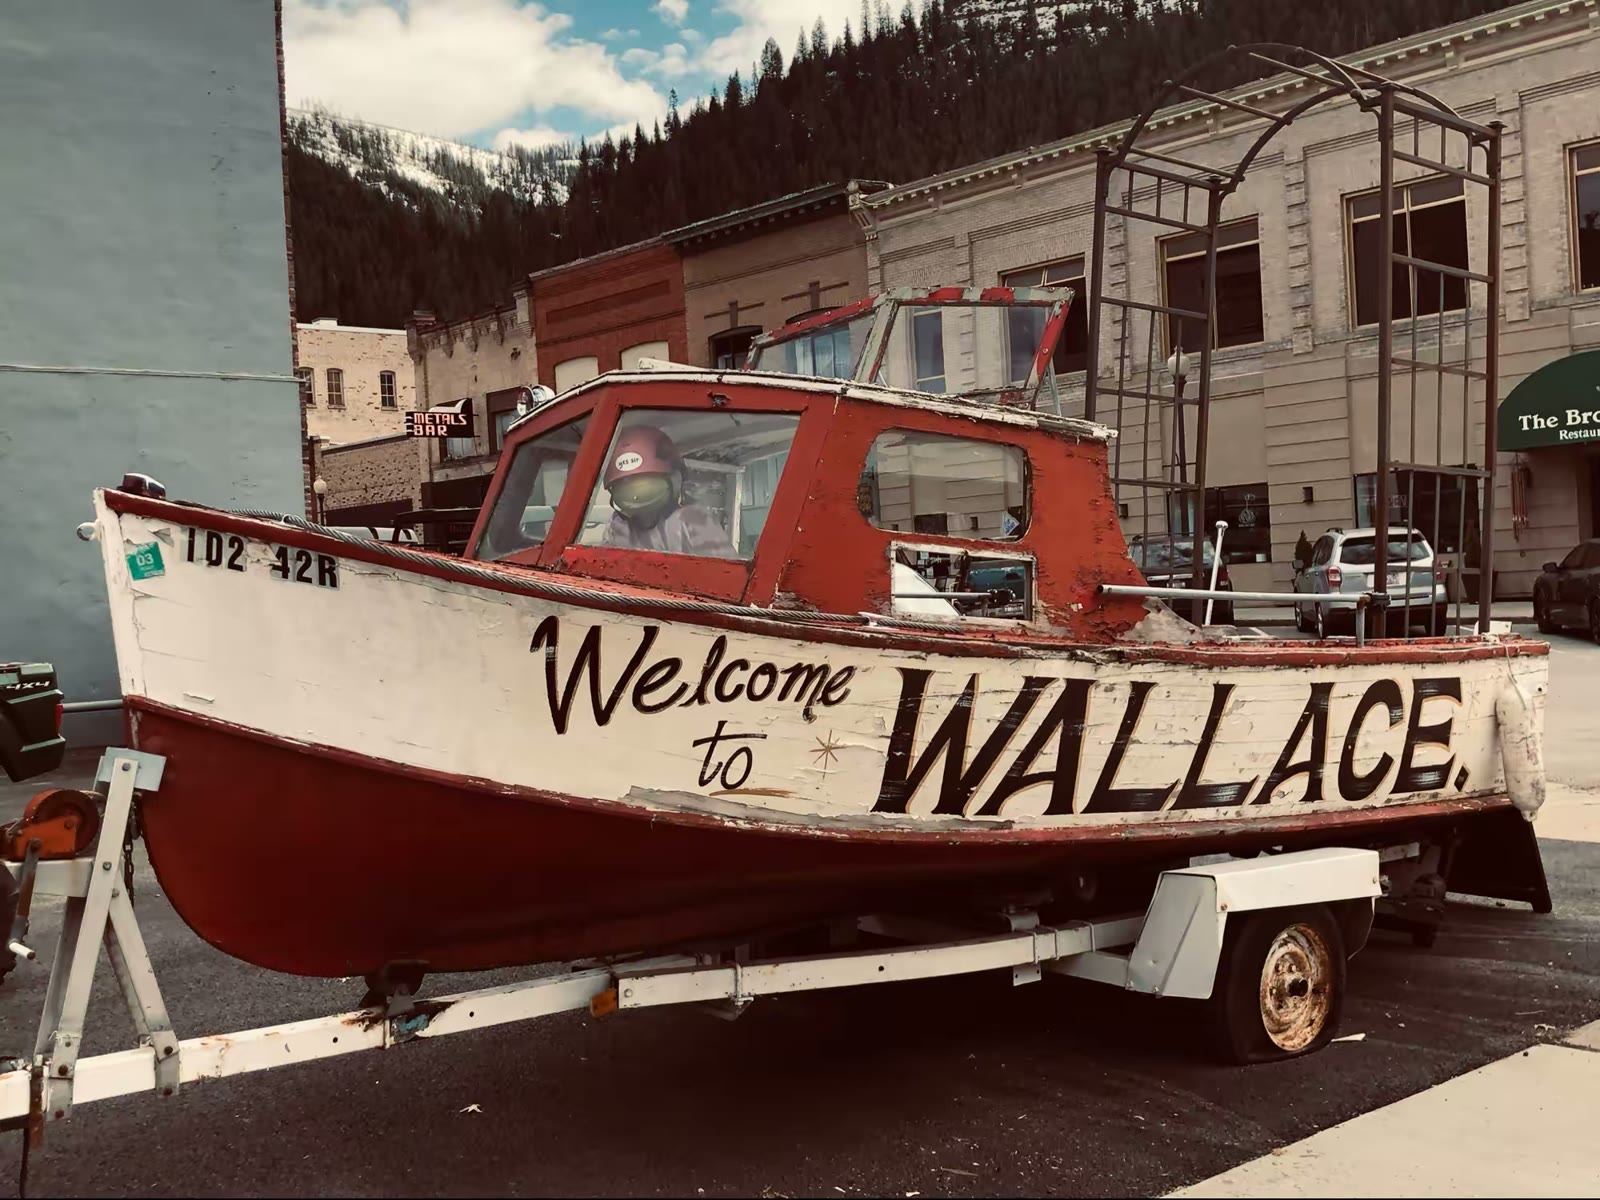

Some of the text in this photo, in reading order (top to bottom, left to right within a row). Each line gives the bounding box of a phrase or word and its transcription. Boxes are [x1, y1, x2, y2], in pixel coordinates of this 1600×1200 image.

[413, 413, 467, 426] METALS
[1518, 413, 1559, 431] The
[413, 425, 448, 436] BAR
[618, 459, 629, 470] yes
[136, 553, 154, 566] 03
[529, 615, 857, 735] Welcome
[869, 667, 1470, 817] WALLACE.
[692, 720, 767, 790] to
